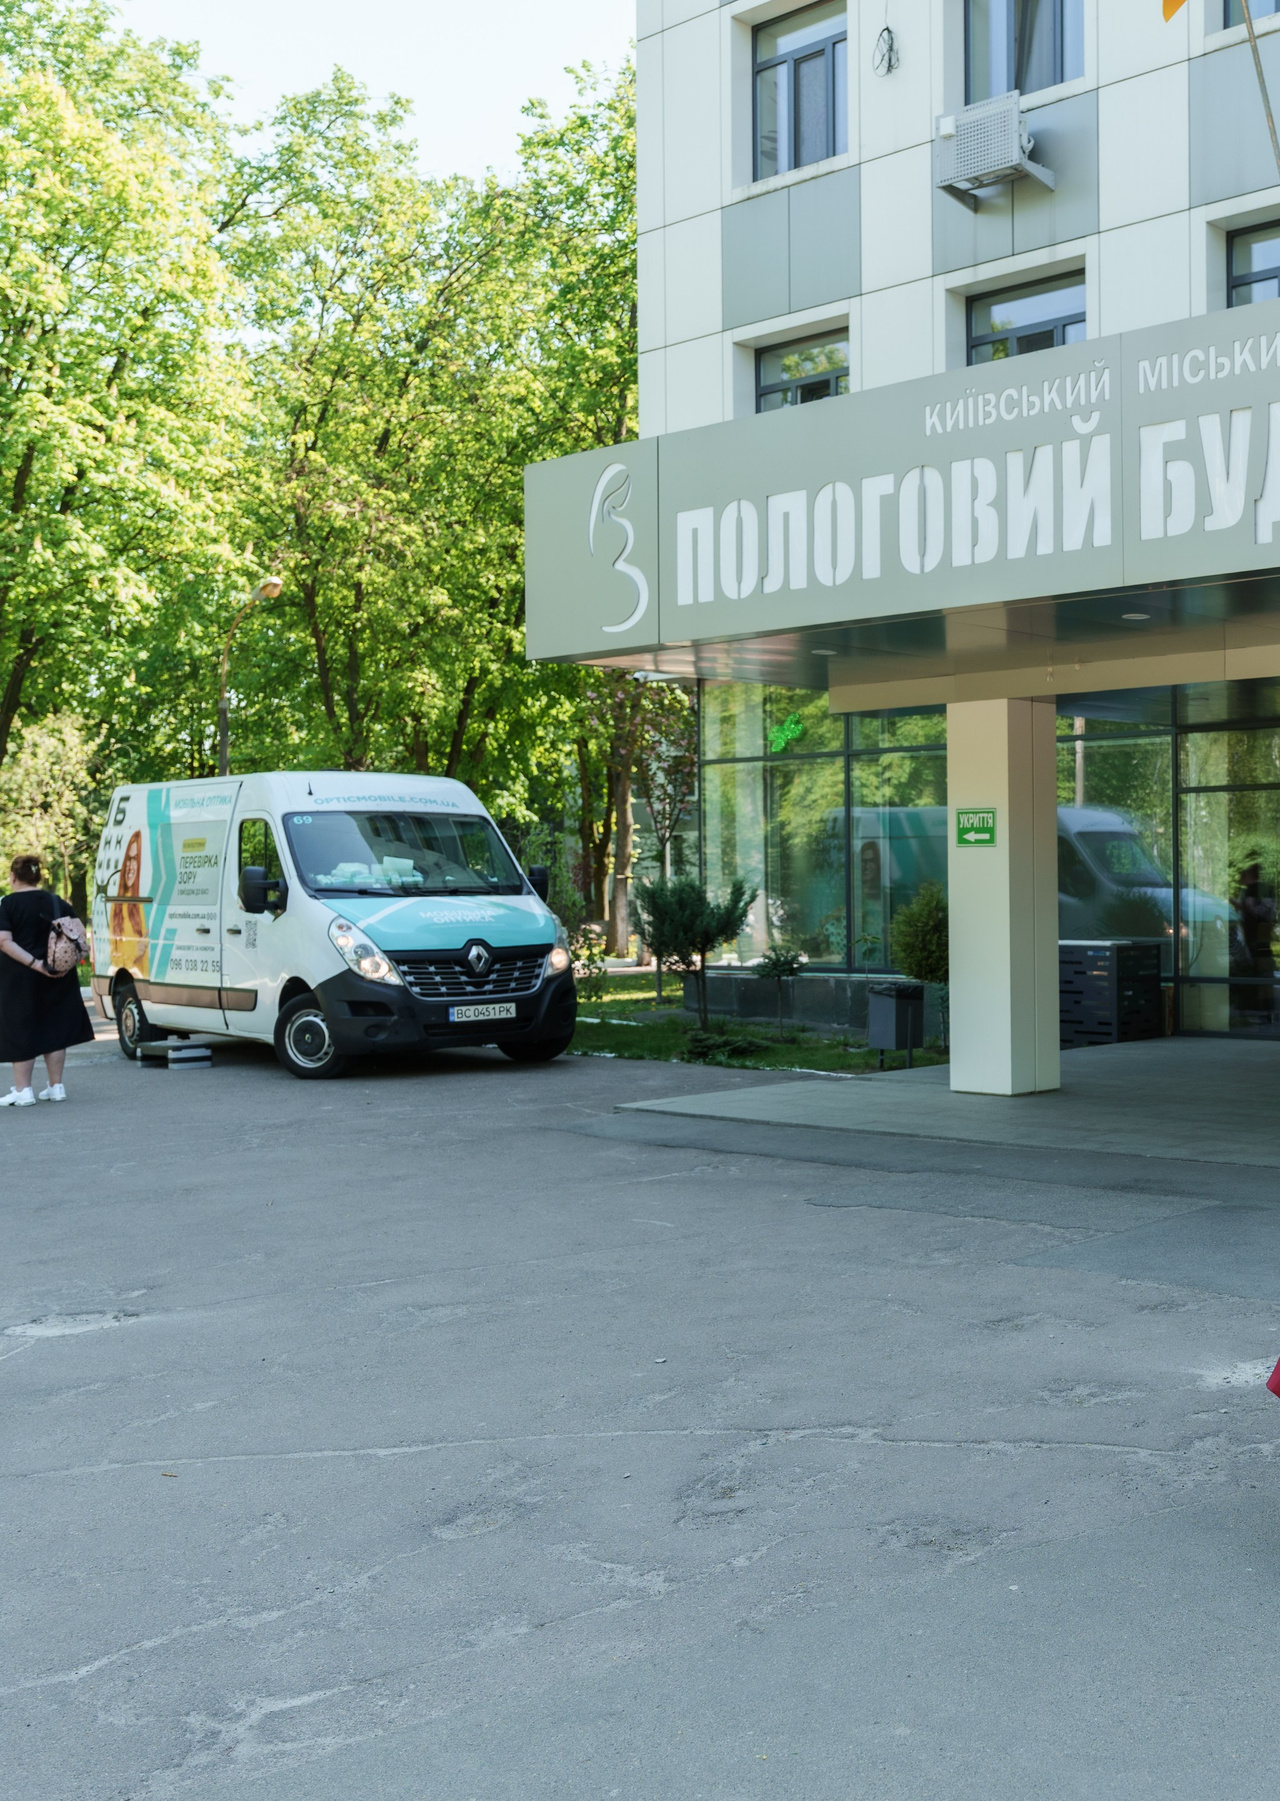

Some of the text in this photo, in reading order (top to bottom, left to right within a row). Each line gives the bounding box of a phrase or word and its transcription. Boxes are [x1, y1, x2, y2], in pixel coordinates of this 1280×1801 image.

[925, 359, 1111, 436] КИЇВСЬКИЙ
[677, 411, 1112, 606] ПОЛОГОВИЙ
[314, 795, 459, 809] OPTICMOBILE.COM.UA
[294, 815, 313, 825] 69
[959, 813, 993, 828] УКРИТТЯ
[179, 854, 218, 869] ПЕРЕВІРКА
[178, 871, 197, 884] ЗОРУ
[170, 958, 220, 973] 096 038 22 55
[473, 1006, 497, 1018] 0451
